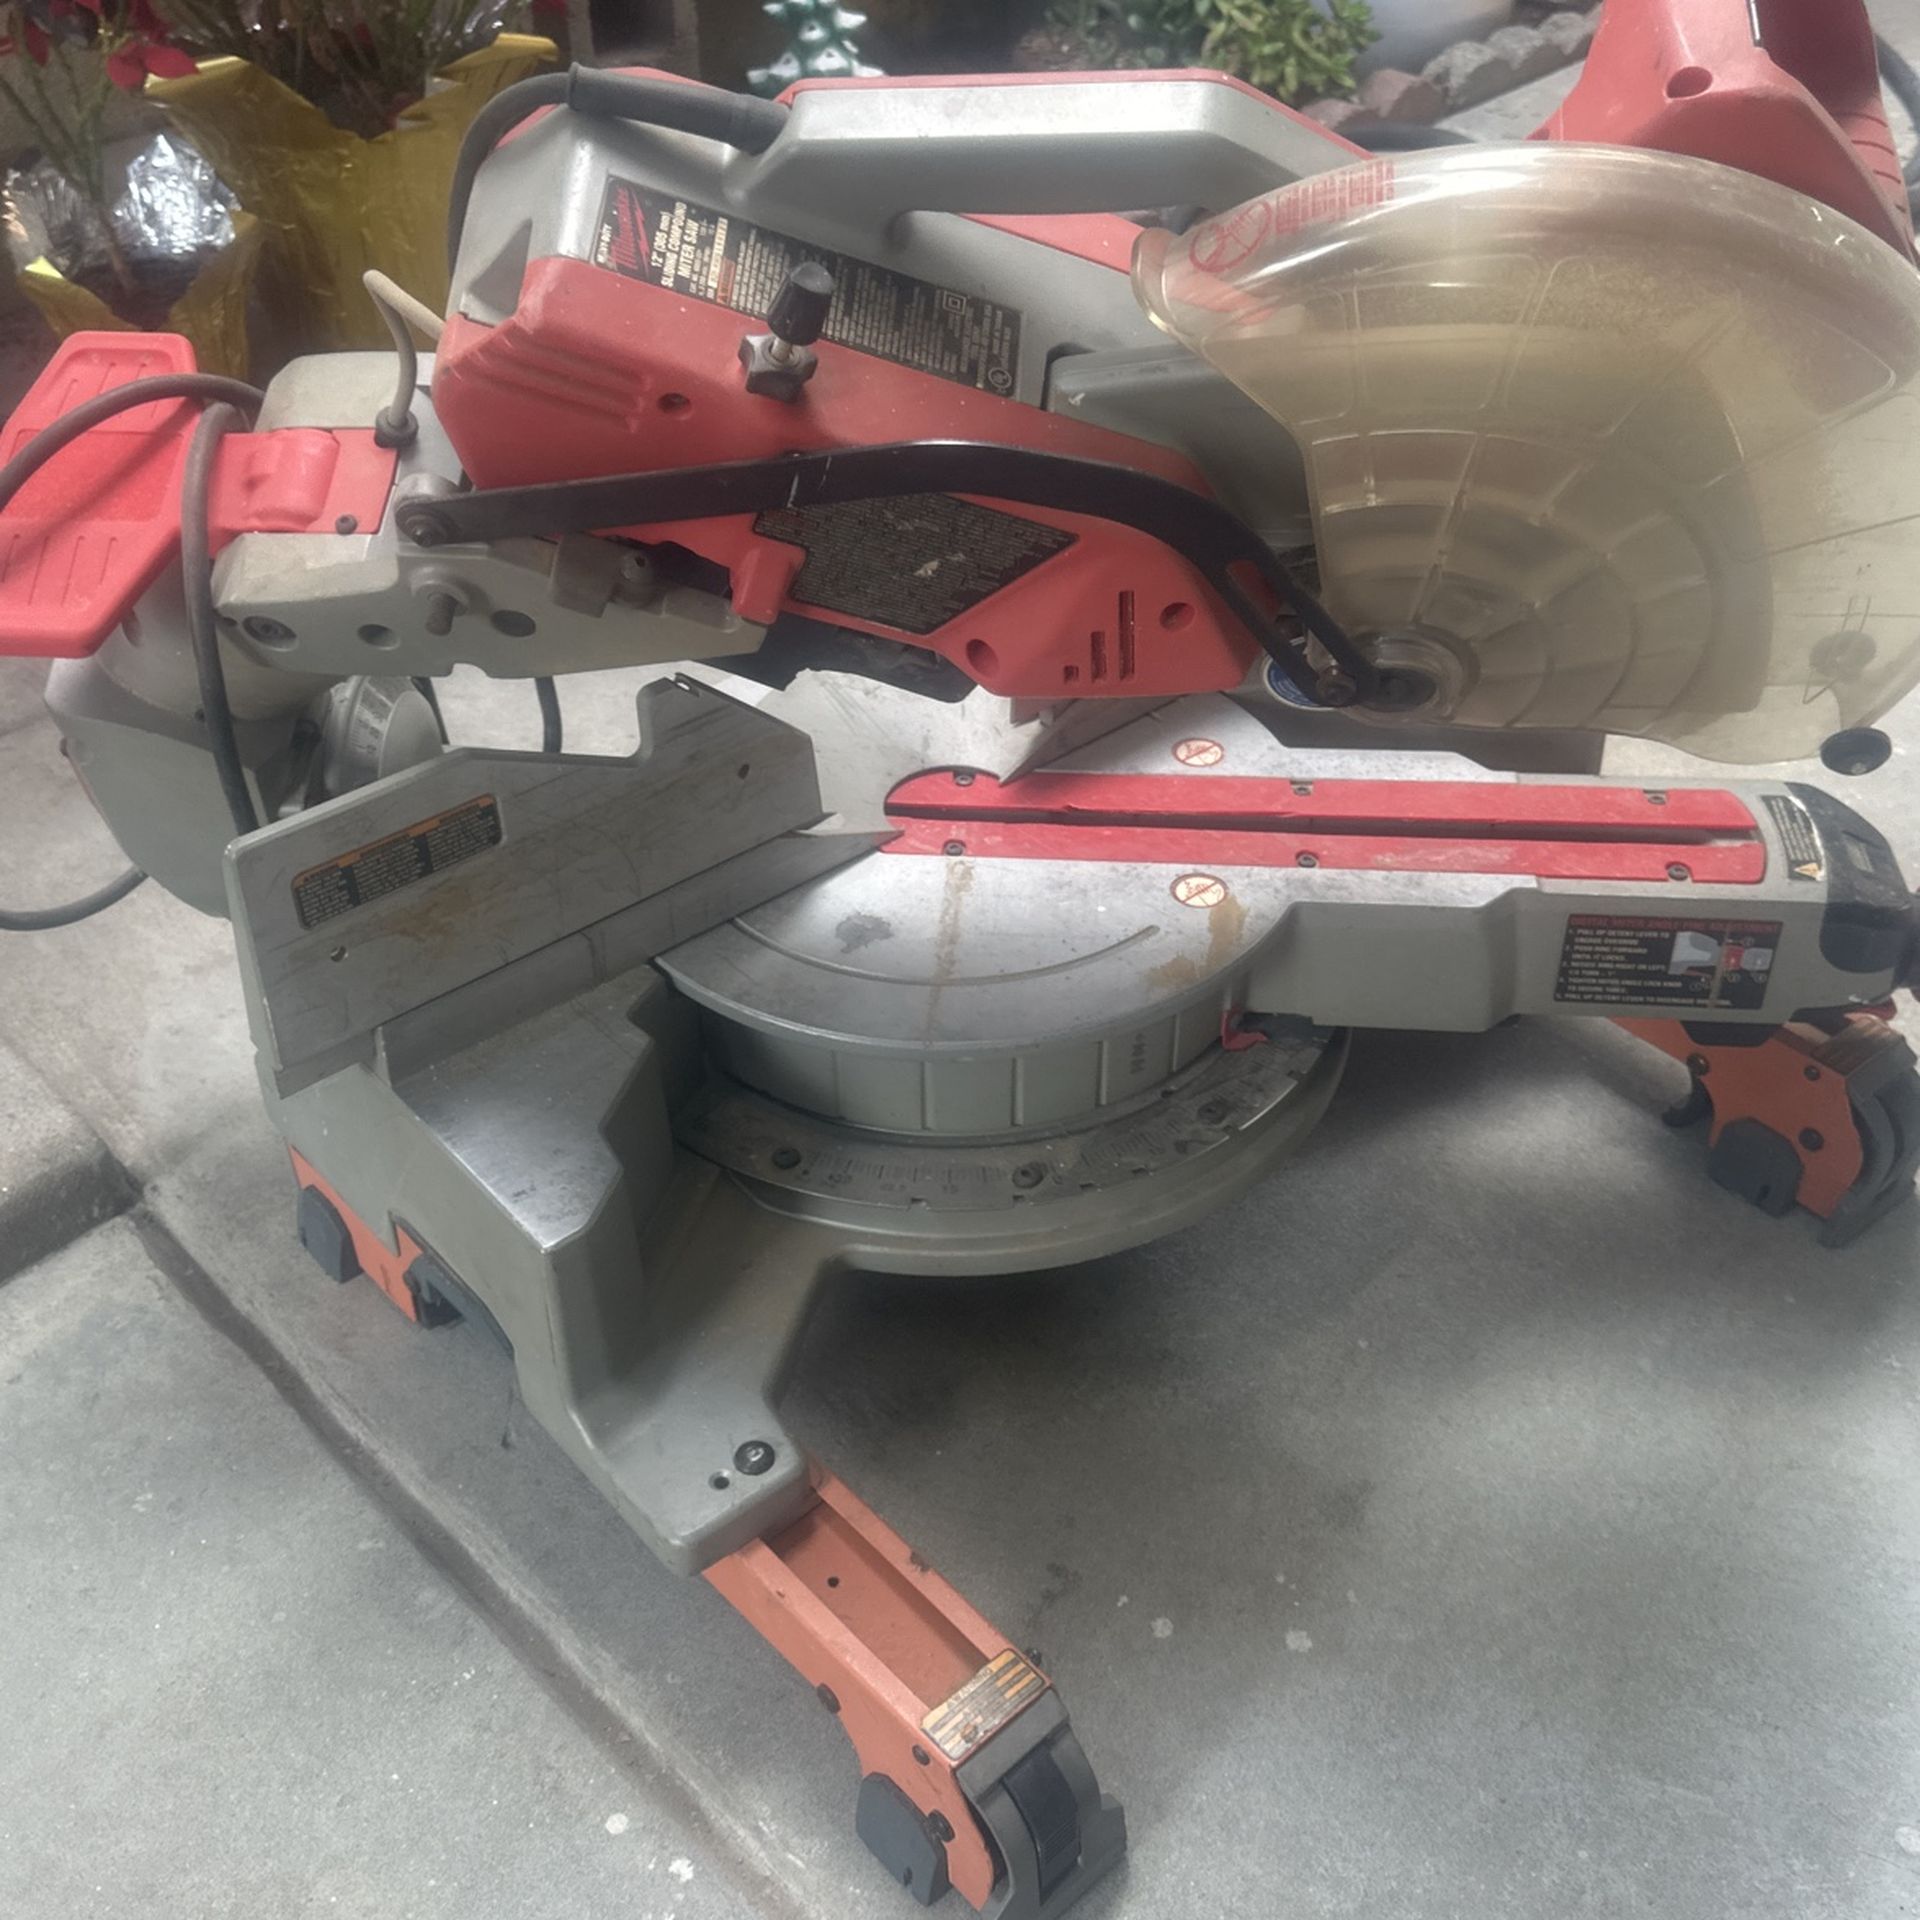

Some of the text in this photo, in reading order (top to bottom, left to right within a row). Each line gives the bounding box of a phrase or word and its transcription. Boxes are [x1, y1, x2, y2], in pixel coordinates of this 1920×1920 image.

[661, 201, 687, 288] SLIDING COMPOUND
[678, 218, 699, 278] MITER SAW
